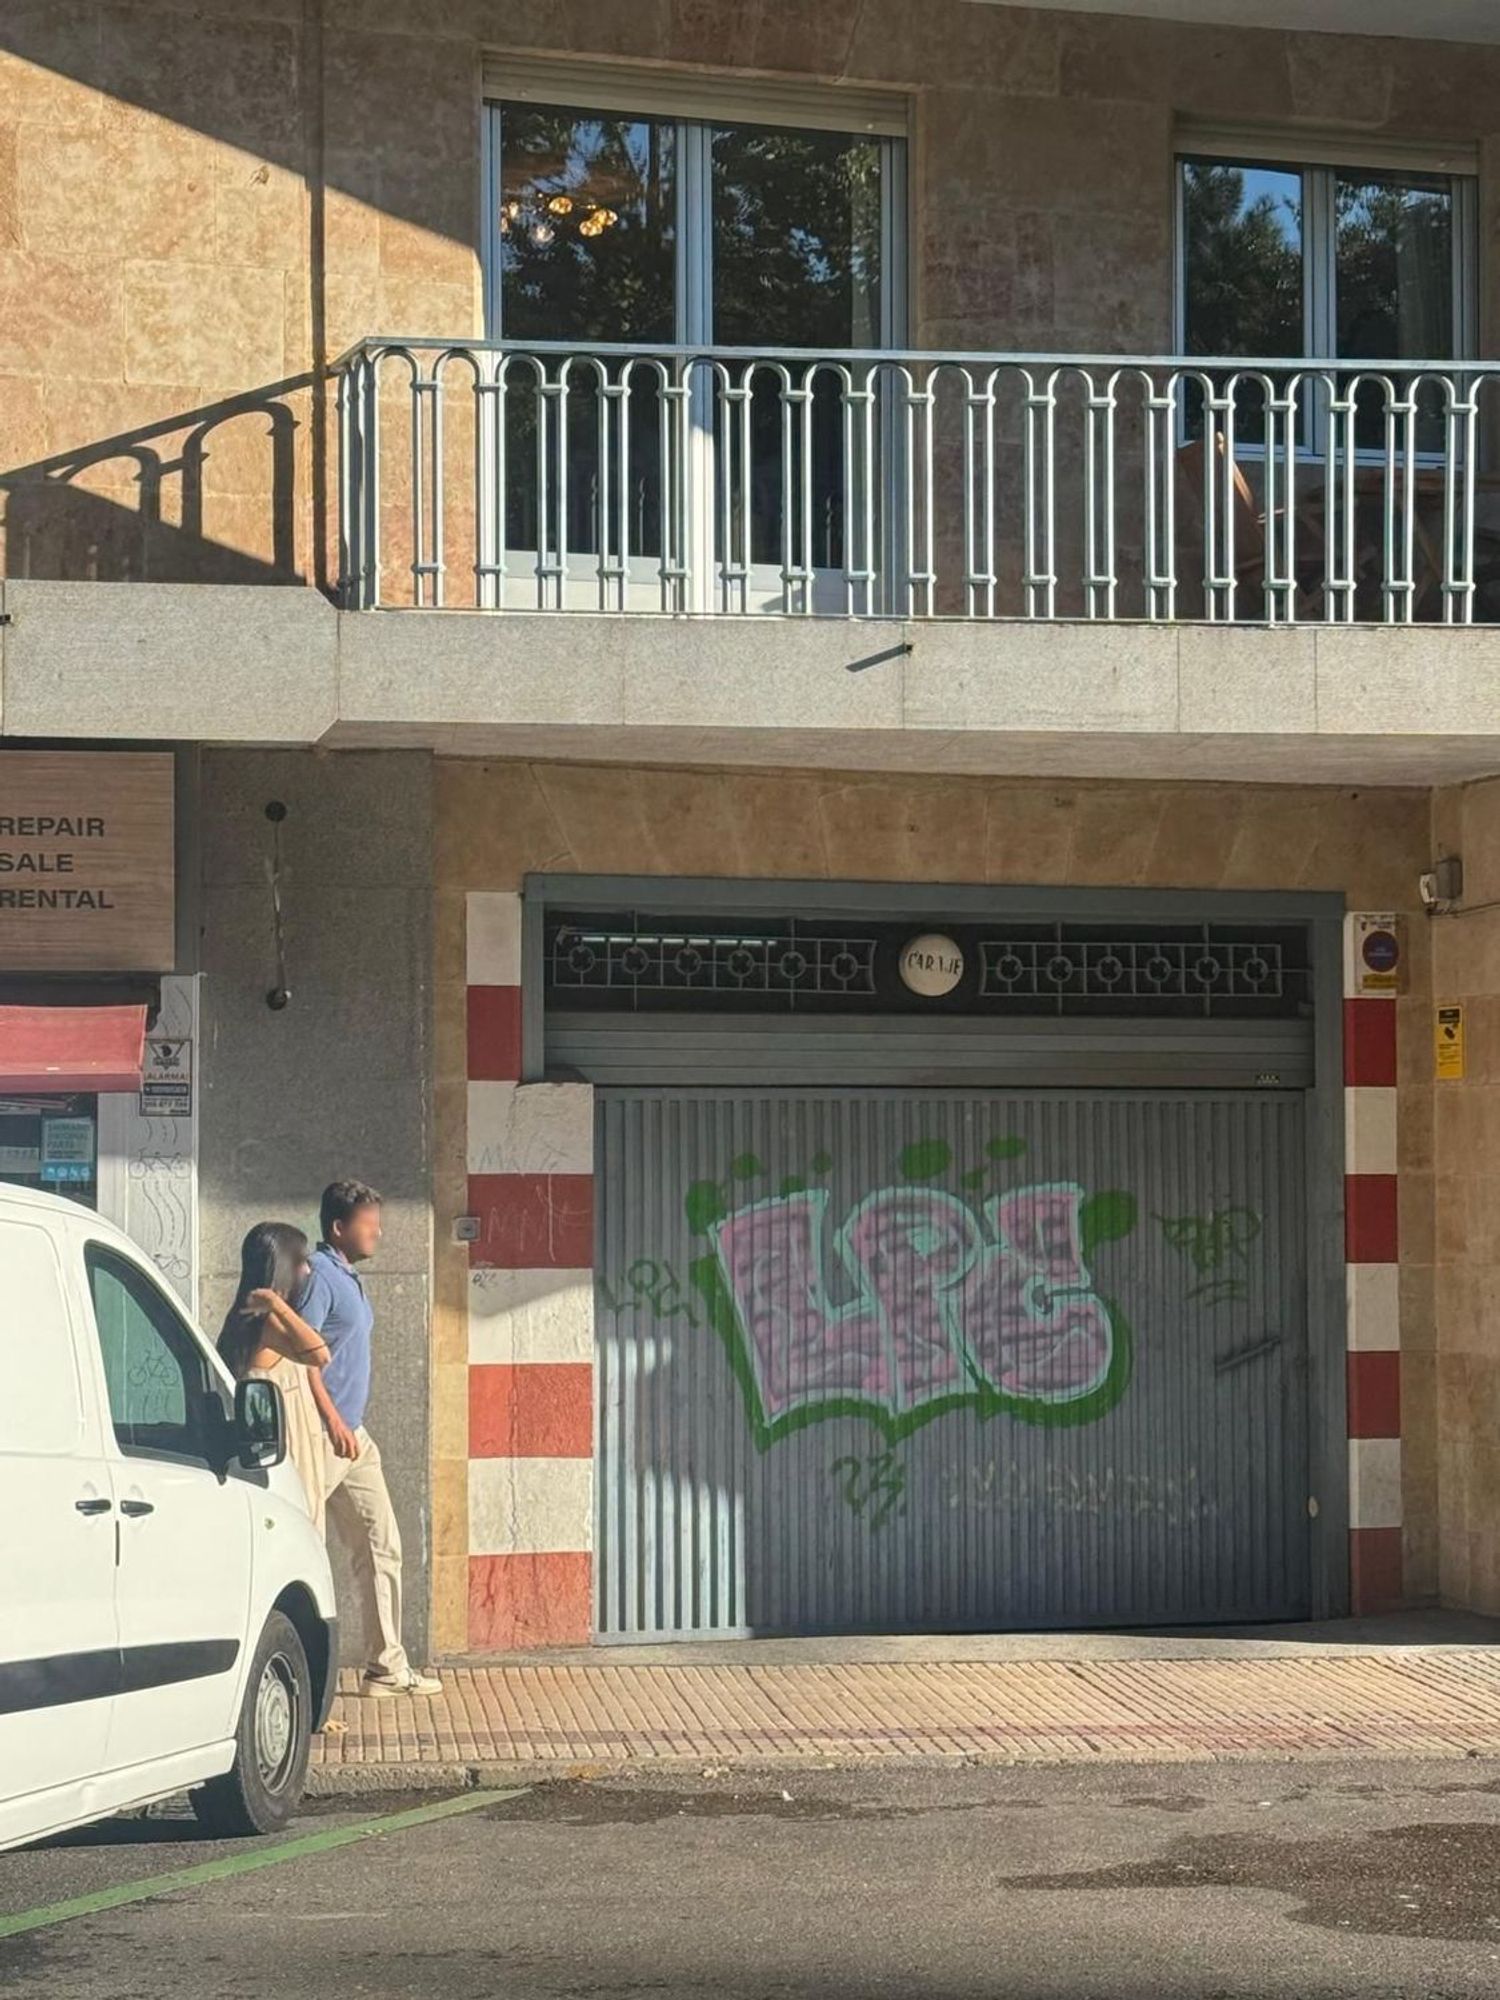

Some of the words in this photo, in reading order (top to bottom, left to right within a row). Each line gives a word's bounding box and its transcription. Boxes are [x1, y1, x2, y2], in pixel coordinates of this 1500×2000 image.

[0, 816, 105, 837] REPAIR
[0, 853, 74, 873] SALE
[0, 889, 115, 909] RENTAL
